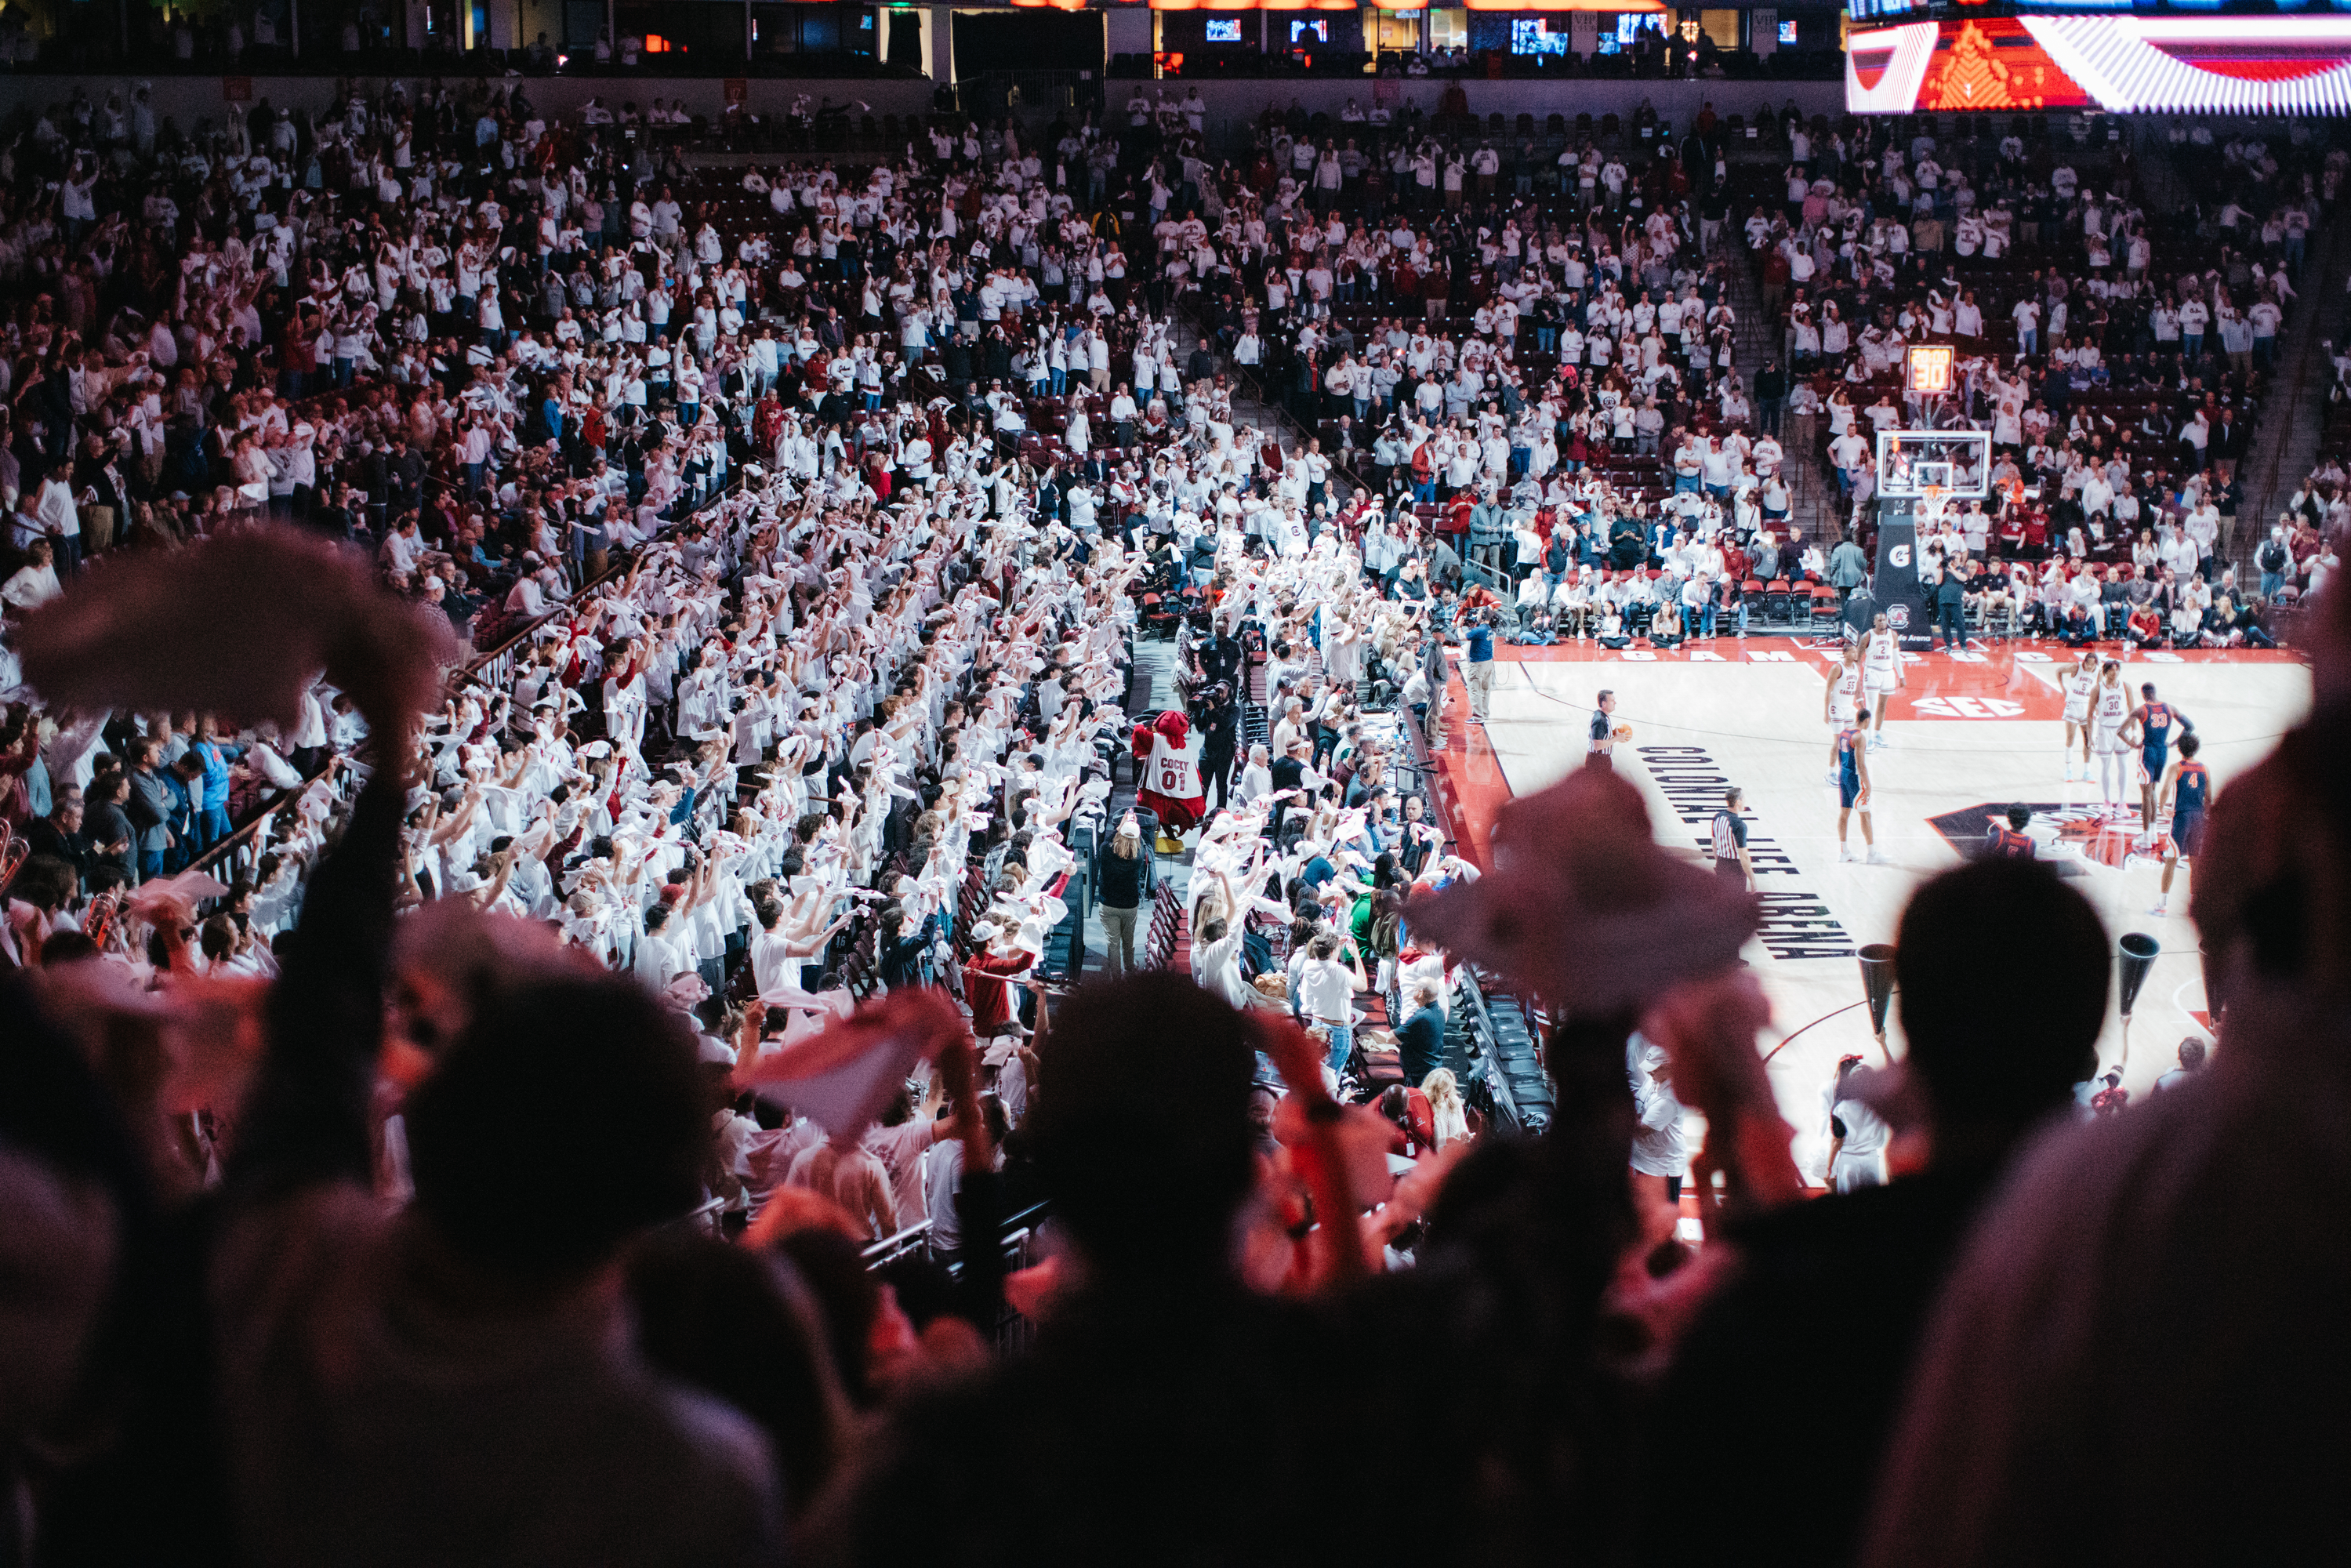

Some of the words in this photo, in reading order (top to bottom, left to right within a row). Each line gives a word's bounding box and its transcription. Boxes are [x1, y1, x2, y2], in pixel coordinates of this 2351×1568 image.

[1574, 14, 1595, 24] VIP
[1754, 15, 1776, 24] VIP
[1911, 349, 1951, 365] 20:00
[1914, 364, 1946, 390] 30
[1888, 544, 1910, 568] G
[1910, 696, 2026, 717] SEC
[2109, 701, 2119, 710] 30
[2150, 713, 2168, 728] 33
[1161, 757, 1189, 771] COCKY
[1162, 770, 1185, 791] 01
[2188, 772, 2198, 788] 4
[1635, 746, 1760, 824] COLONIAL
[1750, 891, 1858, 960] ARENA
